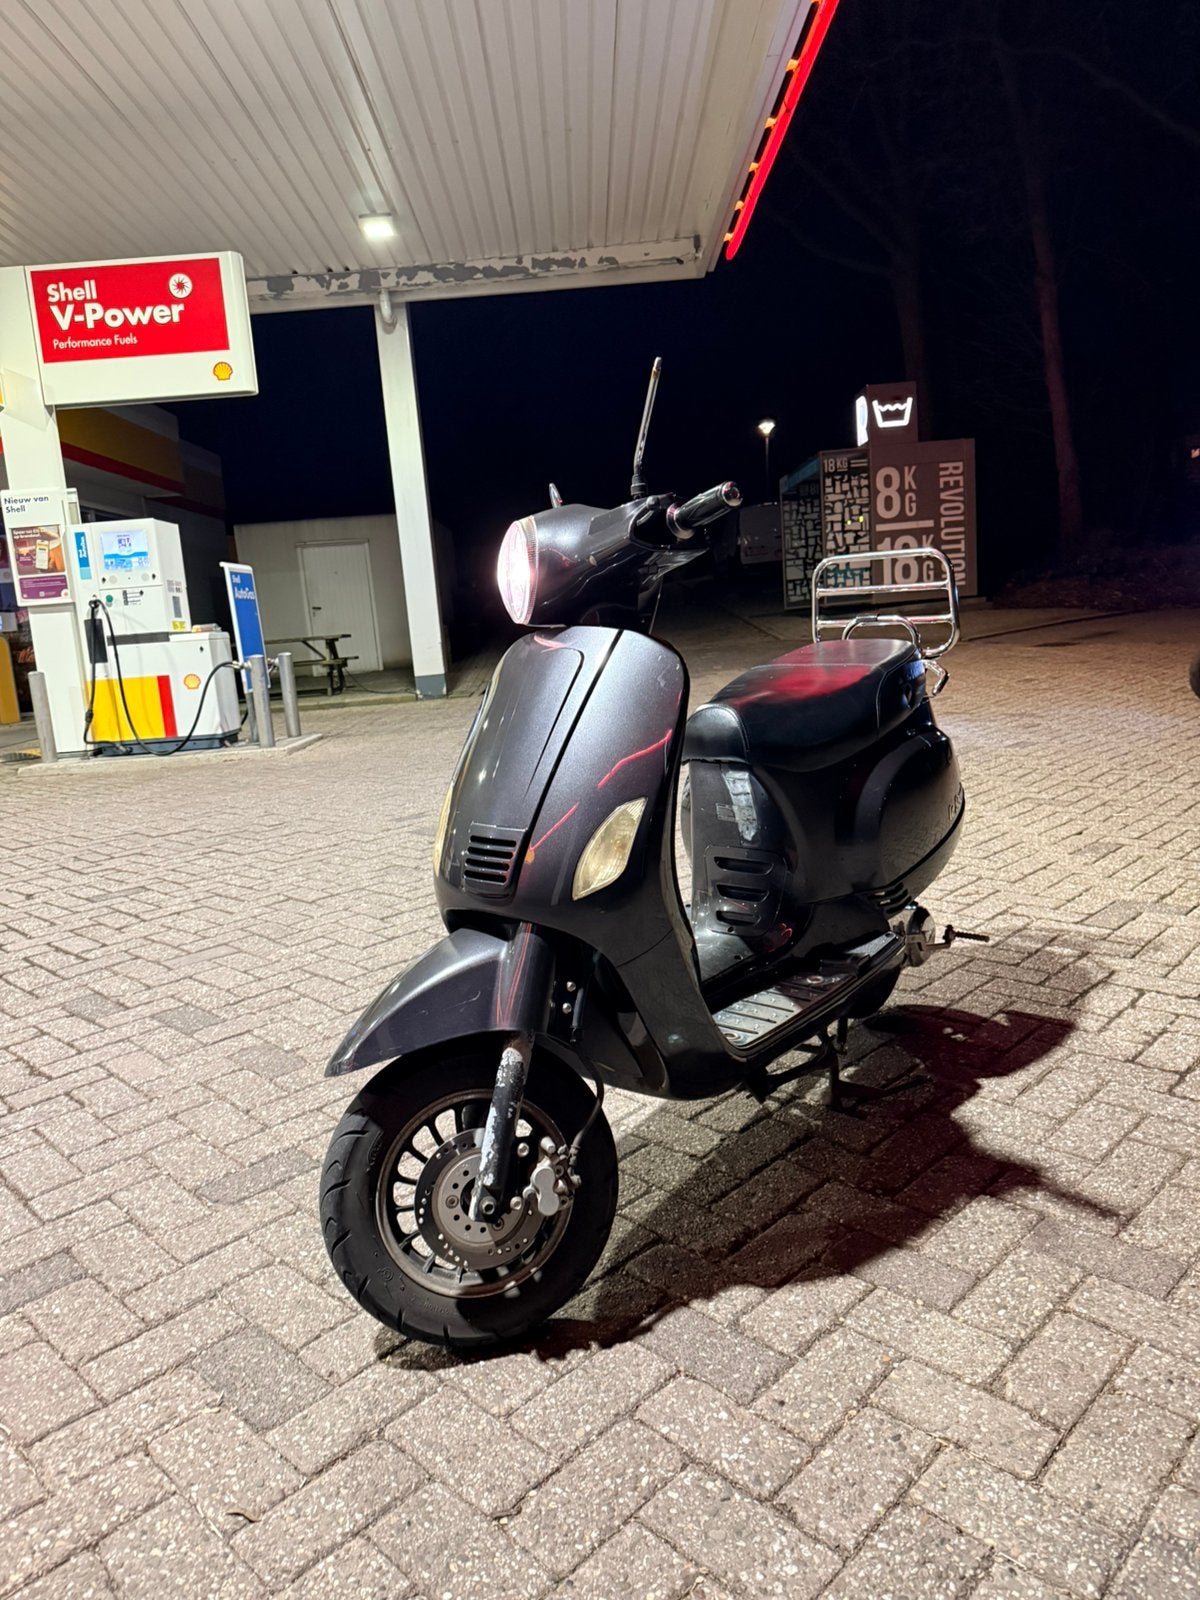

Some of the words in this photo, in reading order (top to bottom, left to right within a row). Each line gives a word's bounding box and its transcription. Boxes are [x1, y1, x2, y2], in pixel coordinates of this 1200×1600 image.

[47, 279, 97, 303] Shell
[50, 303, 185, 331] V-Power
[53, 336, 112, 350] Performance
[114, 333, 138, 346] Fuels
[823, 458, 836, 473] 18
[837, 457, 848, 469] KG
[4, 496, 31, 505] Nieuw
[875, 466, 901, 519] 8
[6, 505, 26, 513] Shell
[939, 461, 967, 587] REVOLUTION
[234, 586, 256, 600] AutoGas
